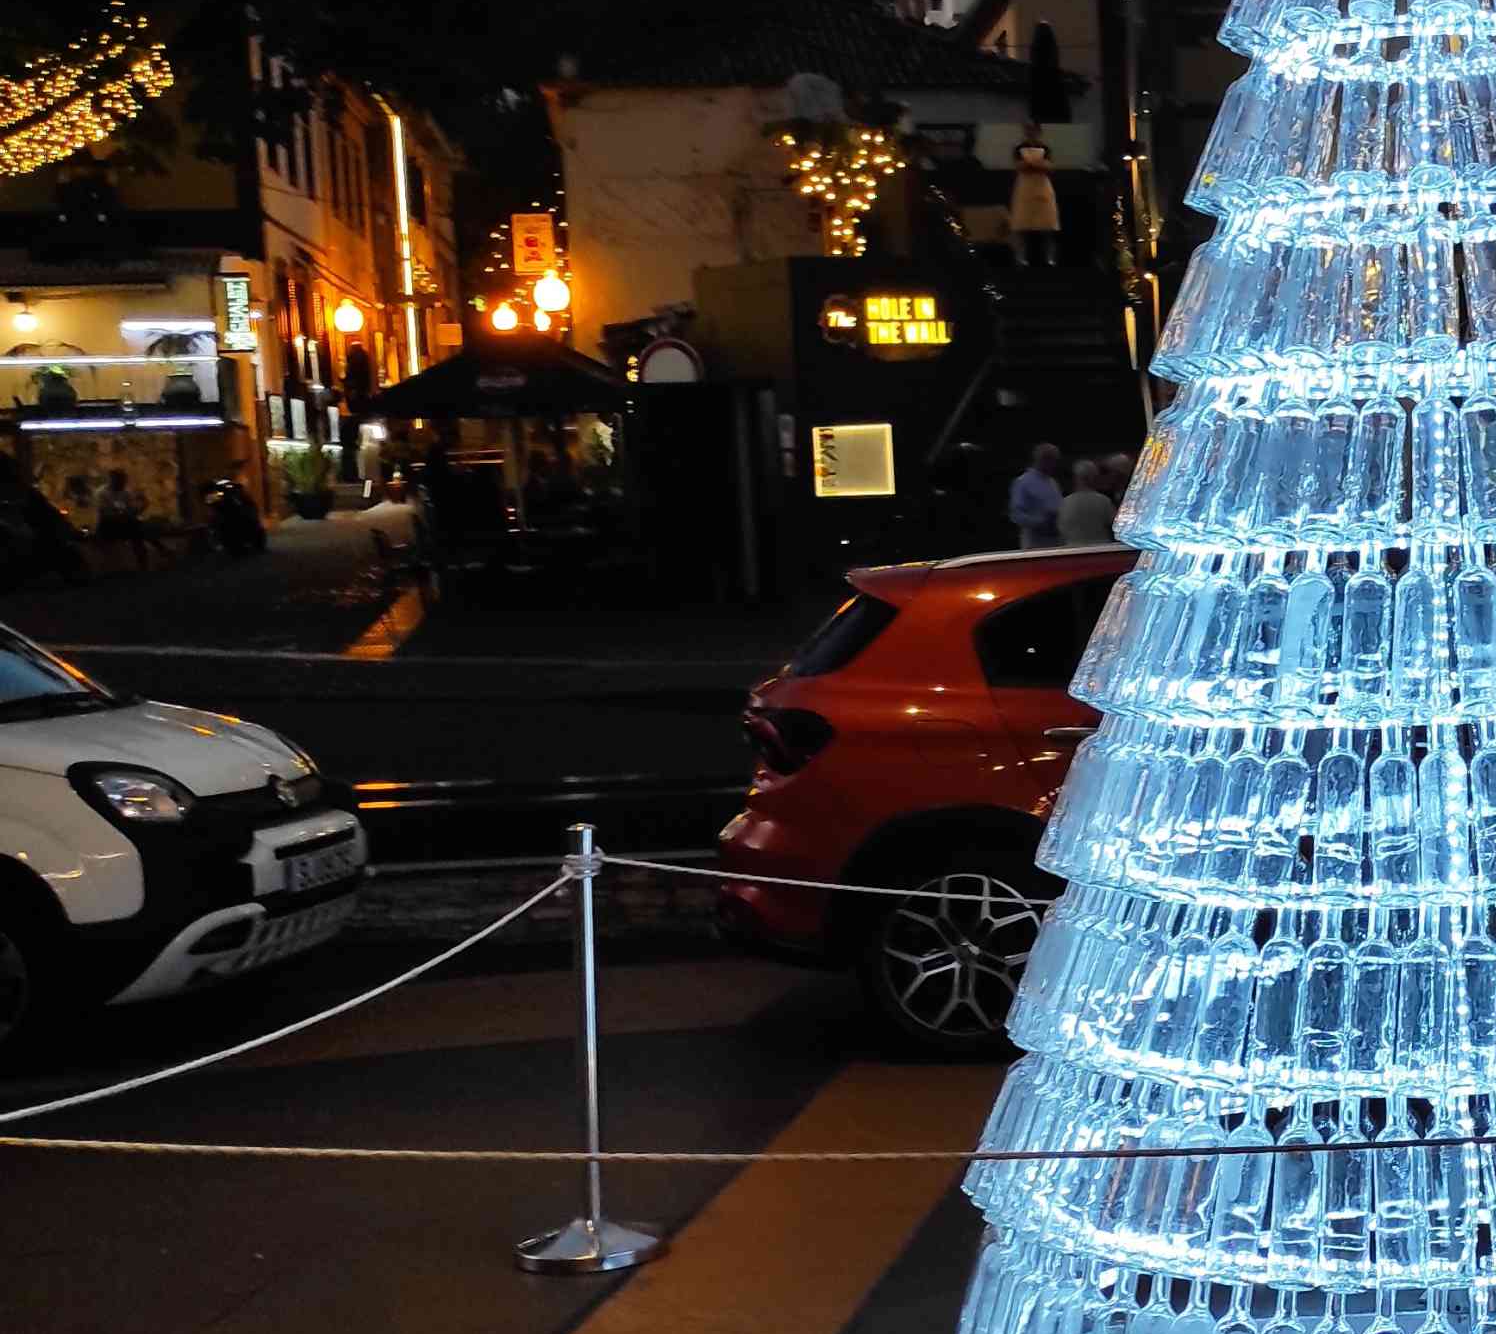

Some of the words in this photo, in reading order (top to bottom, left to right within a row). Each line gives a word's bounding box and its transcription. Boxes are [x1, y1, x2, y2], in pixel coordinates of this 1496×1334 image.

[827, 309, 857, 327] The
[866, 298, 912, 320] HOLE
[914, 298, 936, 320] IN
[866, 321, 903, 344] THE
[903, 321, 951, 344] WALL
